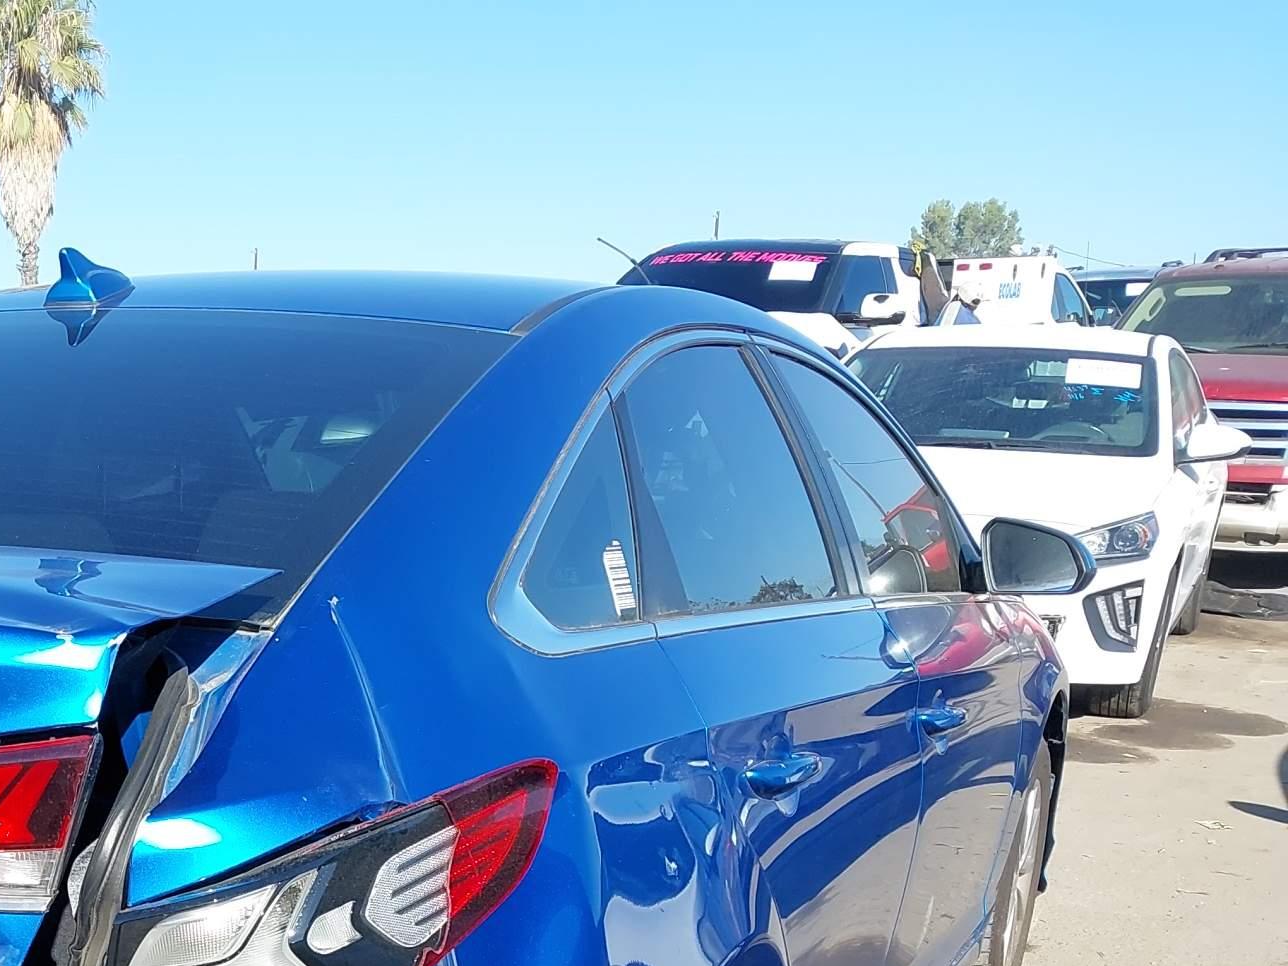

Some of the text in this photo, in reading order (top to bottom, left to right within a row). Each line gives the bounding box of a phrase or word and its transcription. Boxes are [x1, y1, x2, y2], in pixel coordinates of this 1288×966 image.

[649, 255, 674, 266] WE
[671, 253, 702, 263] GOT
[695, 252, 726, 262] ALL
[727, 251, 760, 262] THE
[998, 282, 1021, 300] ECOLAB
